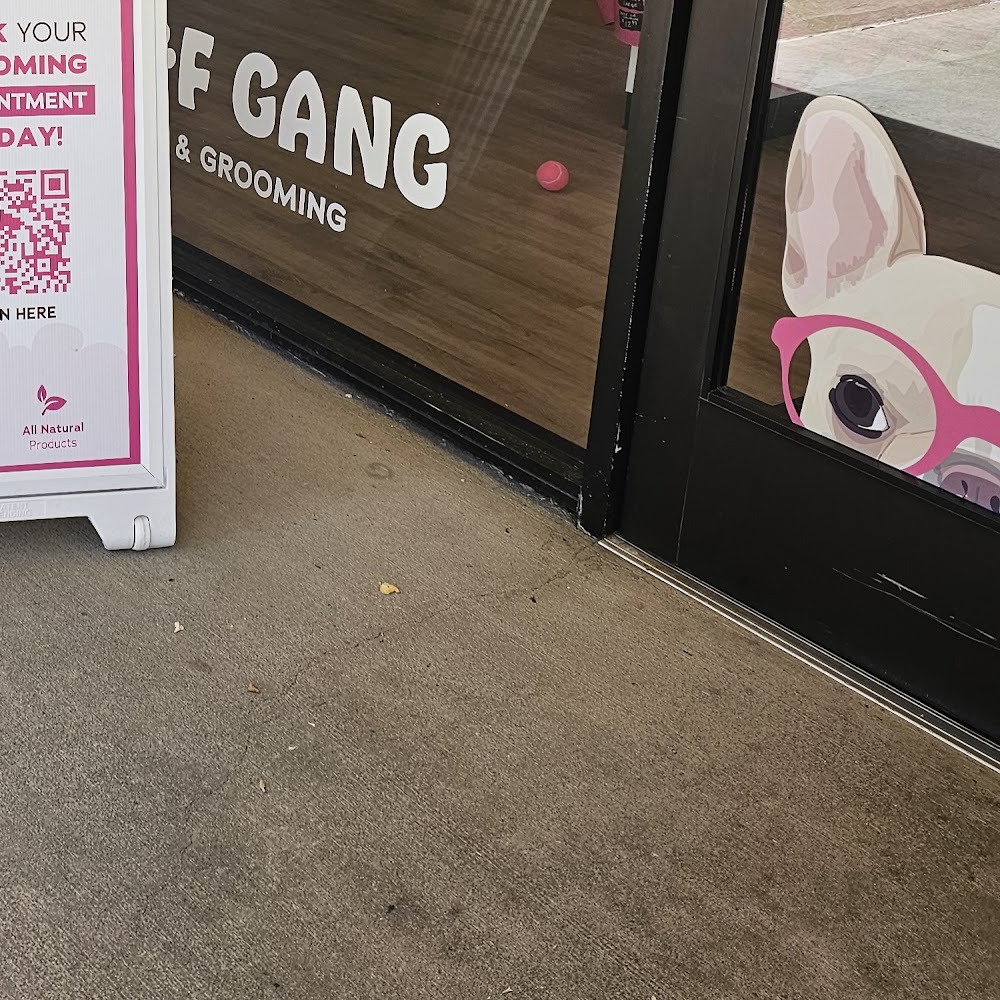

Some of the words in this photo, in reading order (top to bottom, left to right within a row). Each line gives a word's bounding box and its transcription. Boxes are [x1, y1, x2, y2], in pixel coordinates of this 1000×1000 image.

[17, 21, 88, 43] YOUR
[232, 52, 451, 210] GANG
[175, 134, 191, 164] &
[201, 145, 347, 233] GROOMING
[16, 305, 57, 321] HERE
[22, 423, 38, 435] All
[40, 421, 84, 434] Natural
[29, 437, 78, 451] Products
